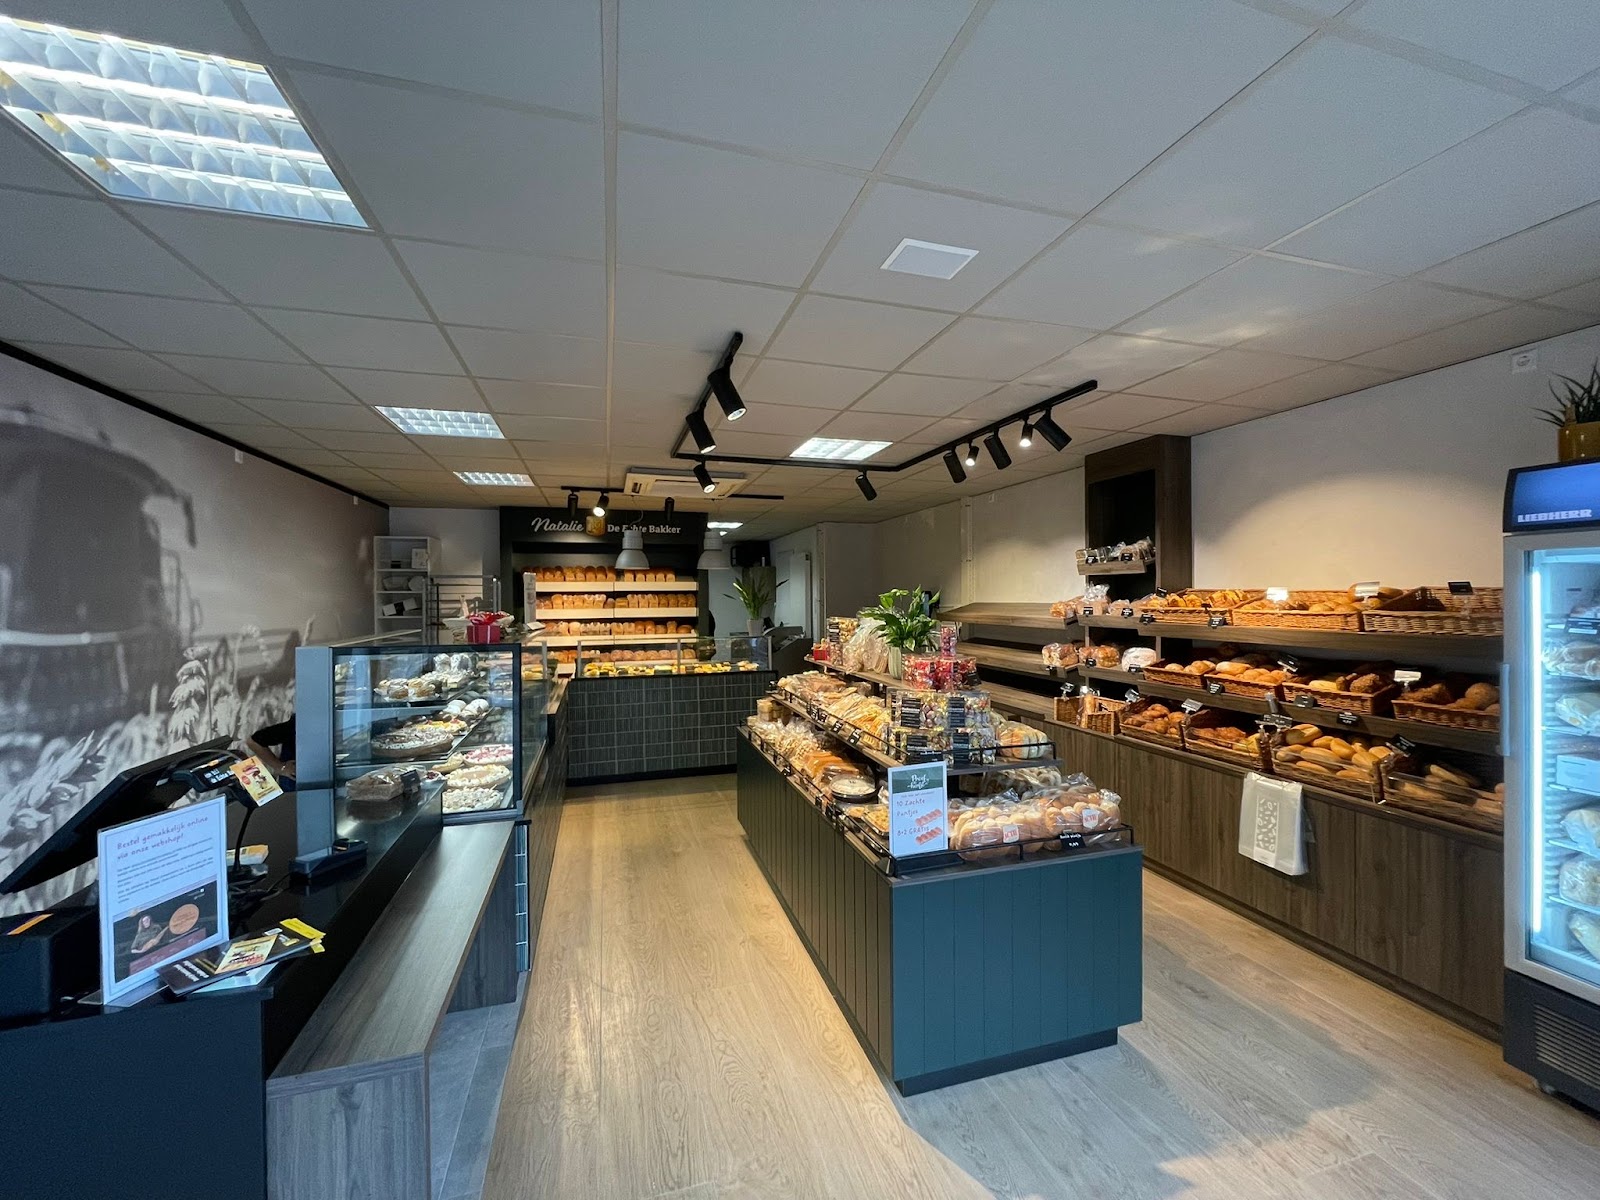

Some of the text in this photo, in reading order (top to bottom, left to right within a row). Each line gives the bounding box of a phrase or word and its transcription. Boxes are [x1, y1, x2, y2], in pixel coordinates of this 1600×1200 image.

[1517, 509, 1592, 523] LIEBHERR
[531, 517, 584, 532] Natalie
[607, 524, 620, 533] De
[648, 525, 682, 534] Bakker
[117, 816, 208, 850] Bestel gemakkelijk online
[117, 851, 128, 860] via
[131, 846, 149, 856] onze
